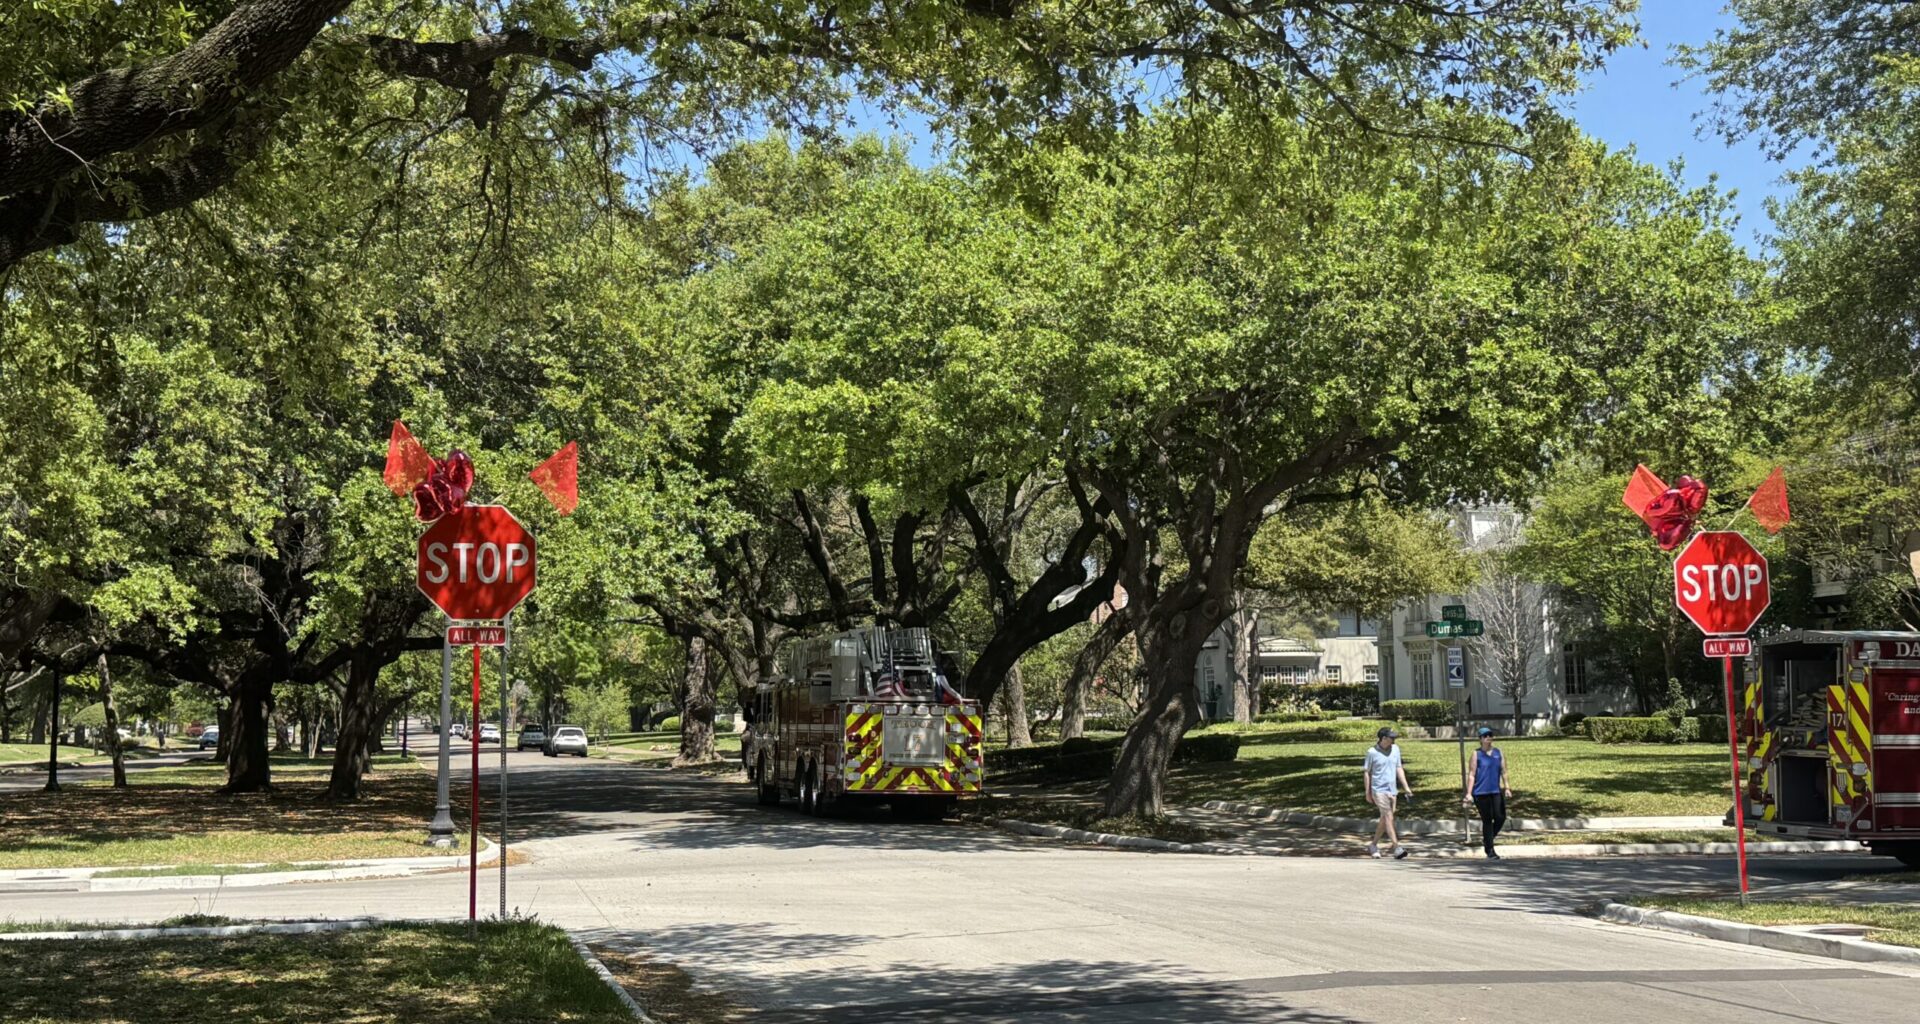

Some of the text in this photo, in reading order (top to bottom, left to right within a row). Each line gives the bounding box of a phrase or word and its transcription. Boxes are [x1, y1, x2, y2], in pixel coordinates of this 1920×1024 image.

[425, 541, 529, 584] STOP
[1682, 563, 1762, 602] STOP
[453, 630, 501, 641] ALL WAY
[1431, 624, 1463, 634] Dumas
[1708, 642, 1746, 653] ALL WAY
[904, 734, 922, 752] 17
